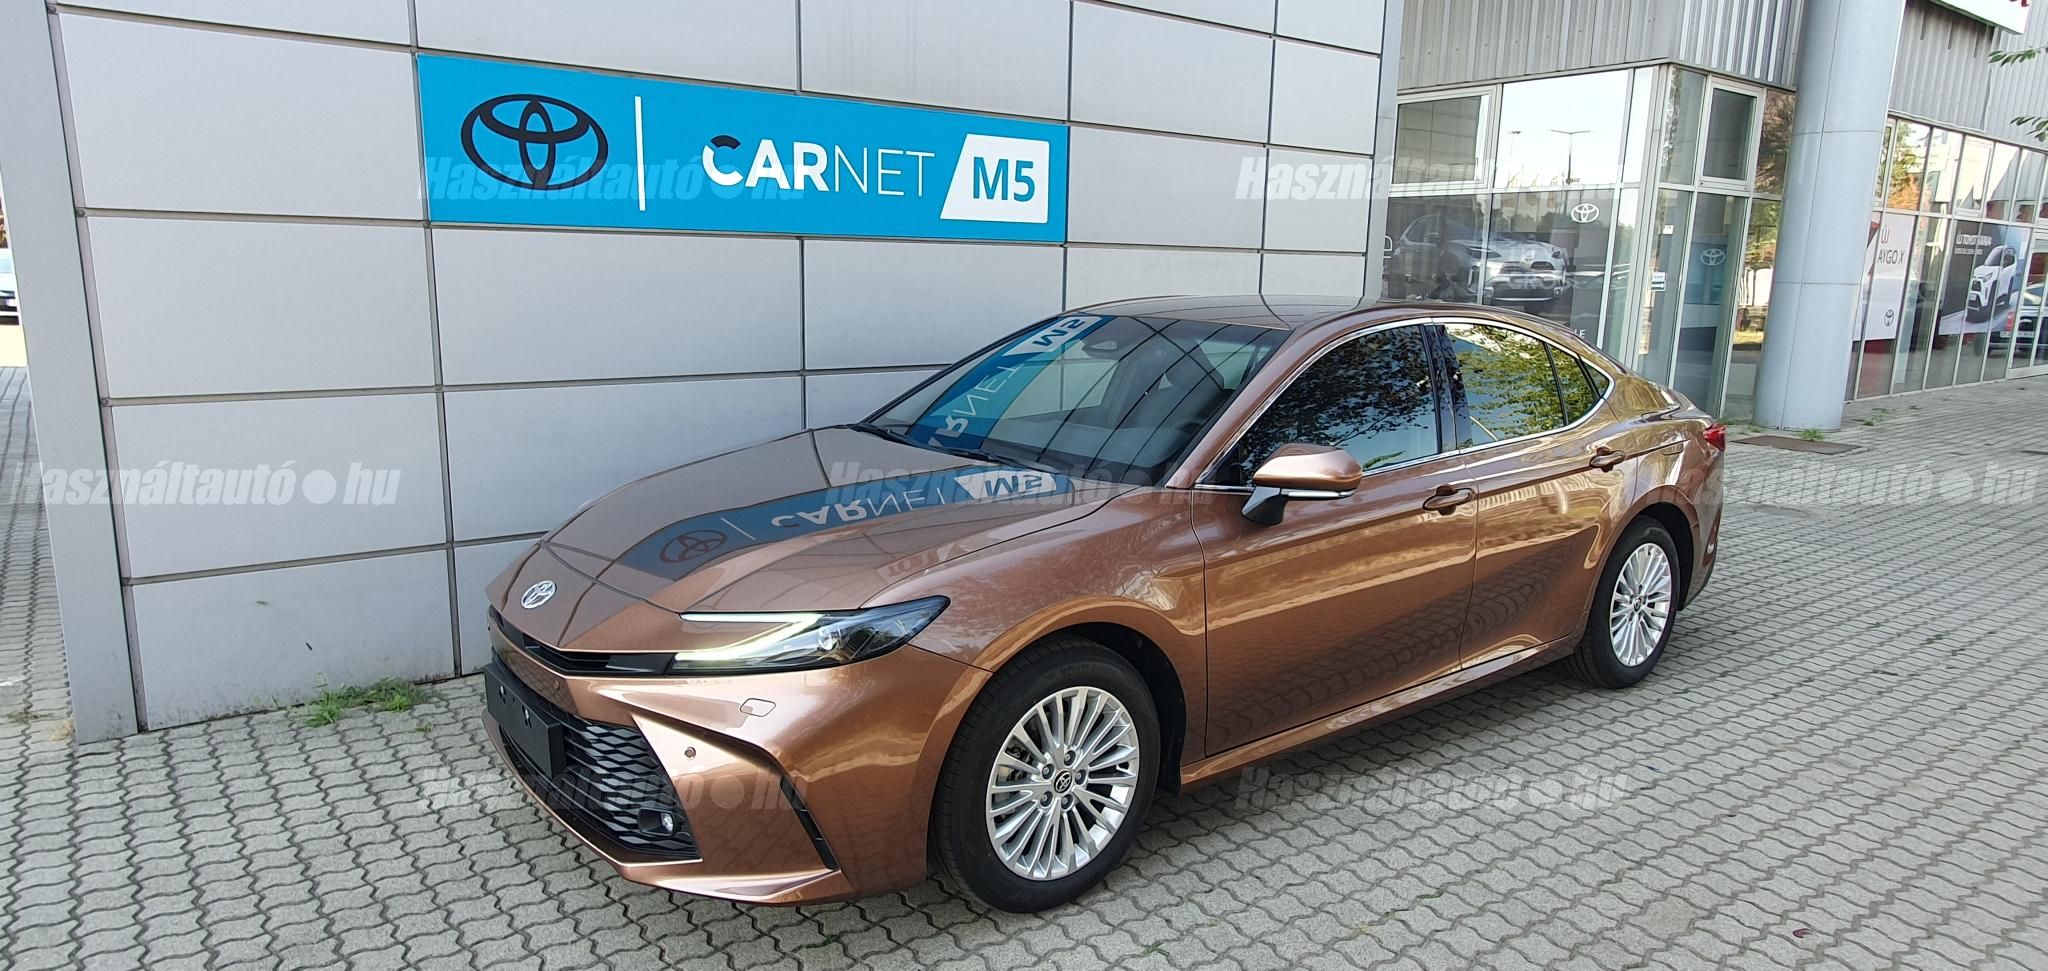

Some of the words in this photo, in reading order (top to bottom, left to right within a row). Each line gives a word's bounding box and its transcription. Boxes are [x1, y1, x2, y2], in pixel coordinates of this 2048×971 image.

[702, 134, 935, 197] CARNET
[972, 156, 1036, 202] M5
[1876, 249, 1898, 265] AYGO
